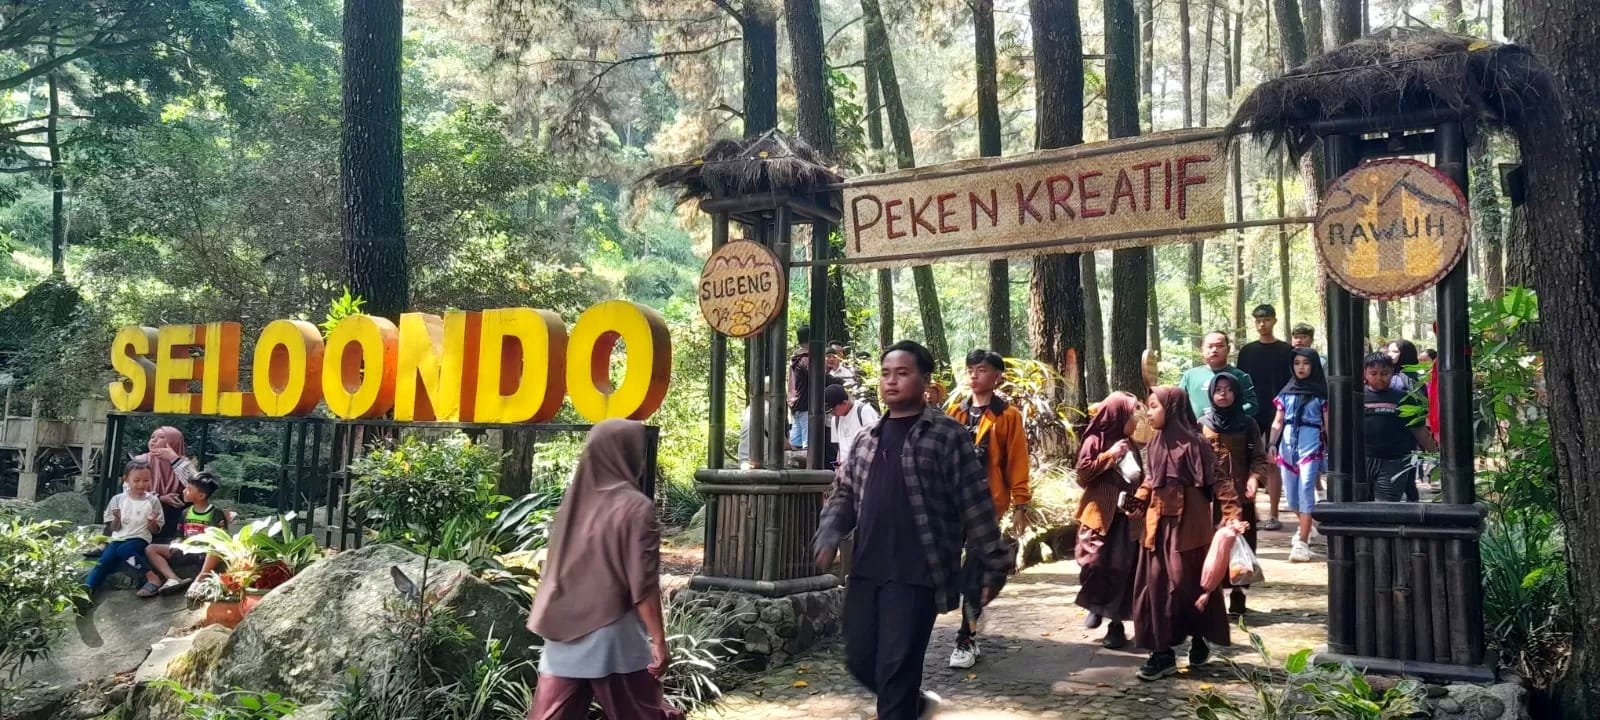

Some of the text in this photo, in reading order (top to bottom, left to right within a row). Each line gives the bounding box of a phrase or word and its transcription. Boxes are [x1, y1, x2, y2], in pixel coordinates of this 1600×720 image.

[852, 154, 1211, 252] PEKEN KREATIF
[1328, 214, 1444, 245] RAWUH
[702, 272, 772, 301] SUGENG
[108, 300, 668, 423] SELOONDO
